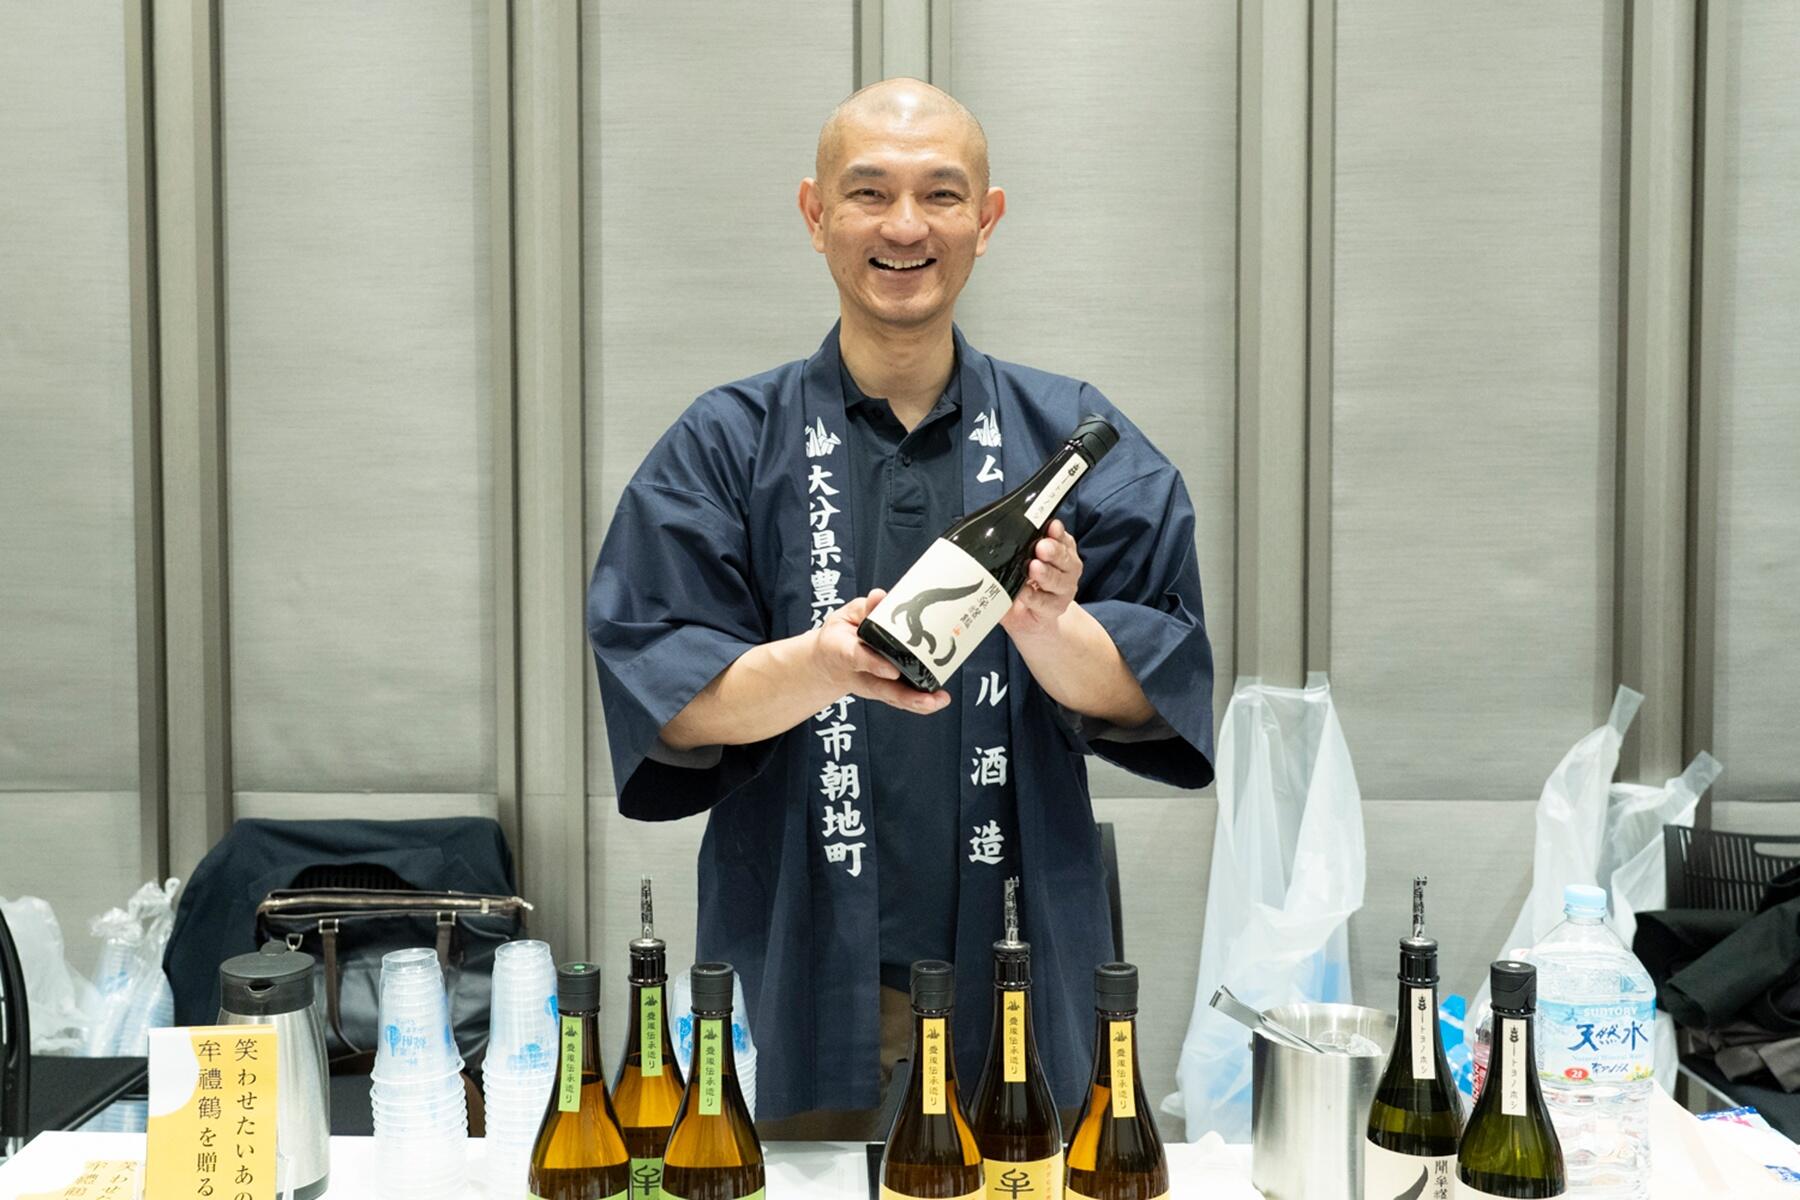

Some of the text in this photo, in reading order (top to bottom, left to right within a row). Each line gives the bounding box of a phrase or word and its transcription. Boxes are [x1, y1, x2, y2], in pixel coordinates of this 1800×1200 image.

[1567, 1020, 1649, 1052] 天然水
[196, 1039, 222, 1197] 牟禮鶴を贈る
